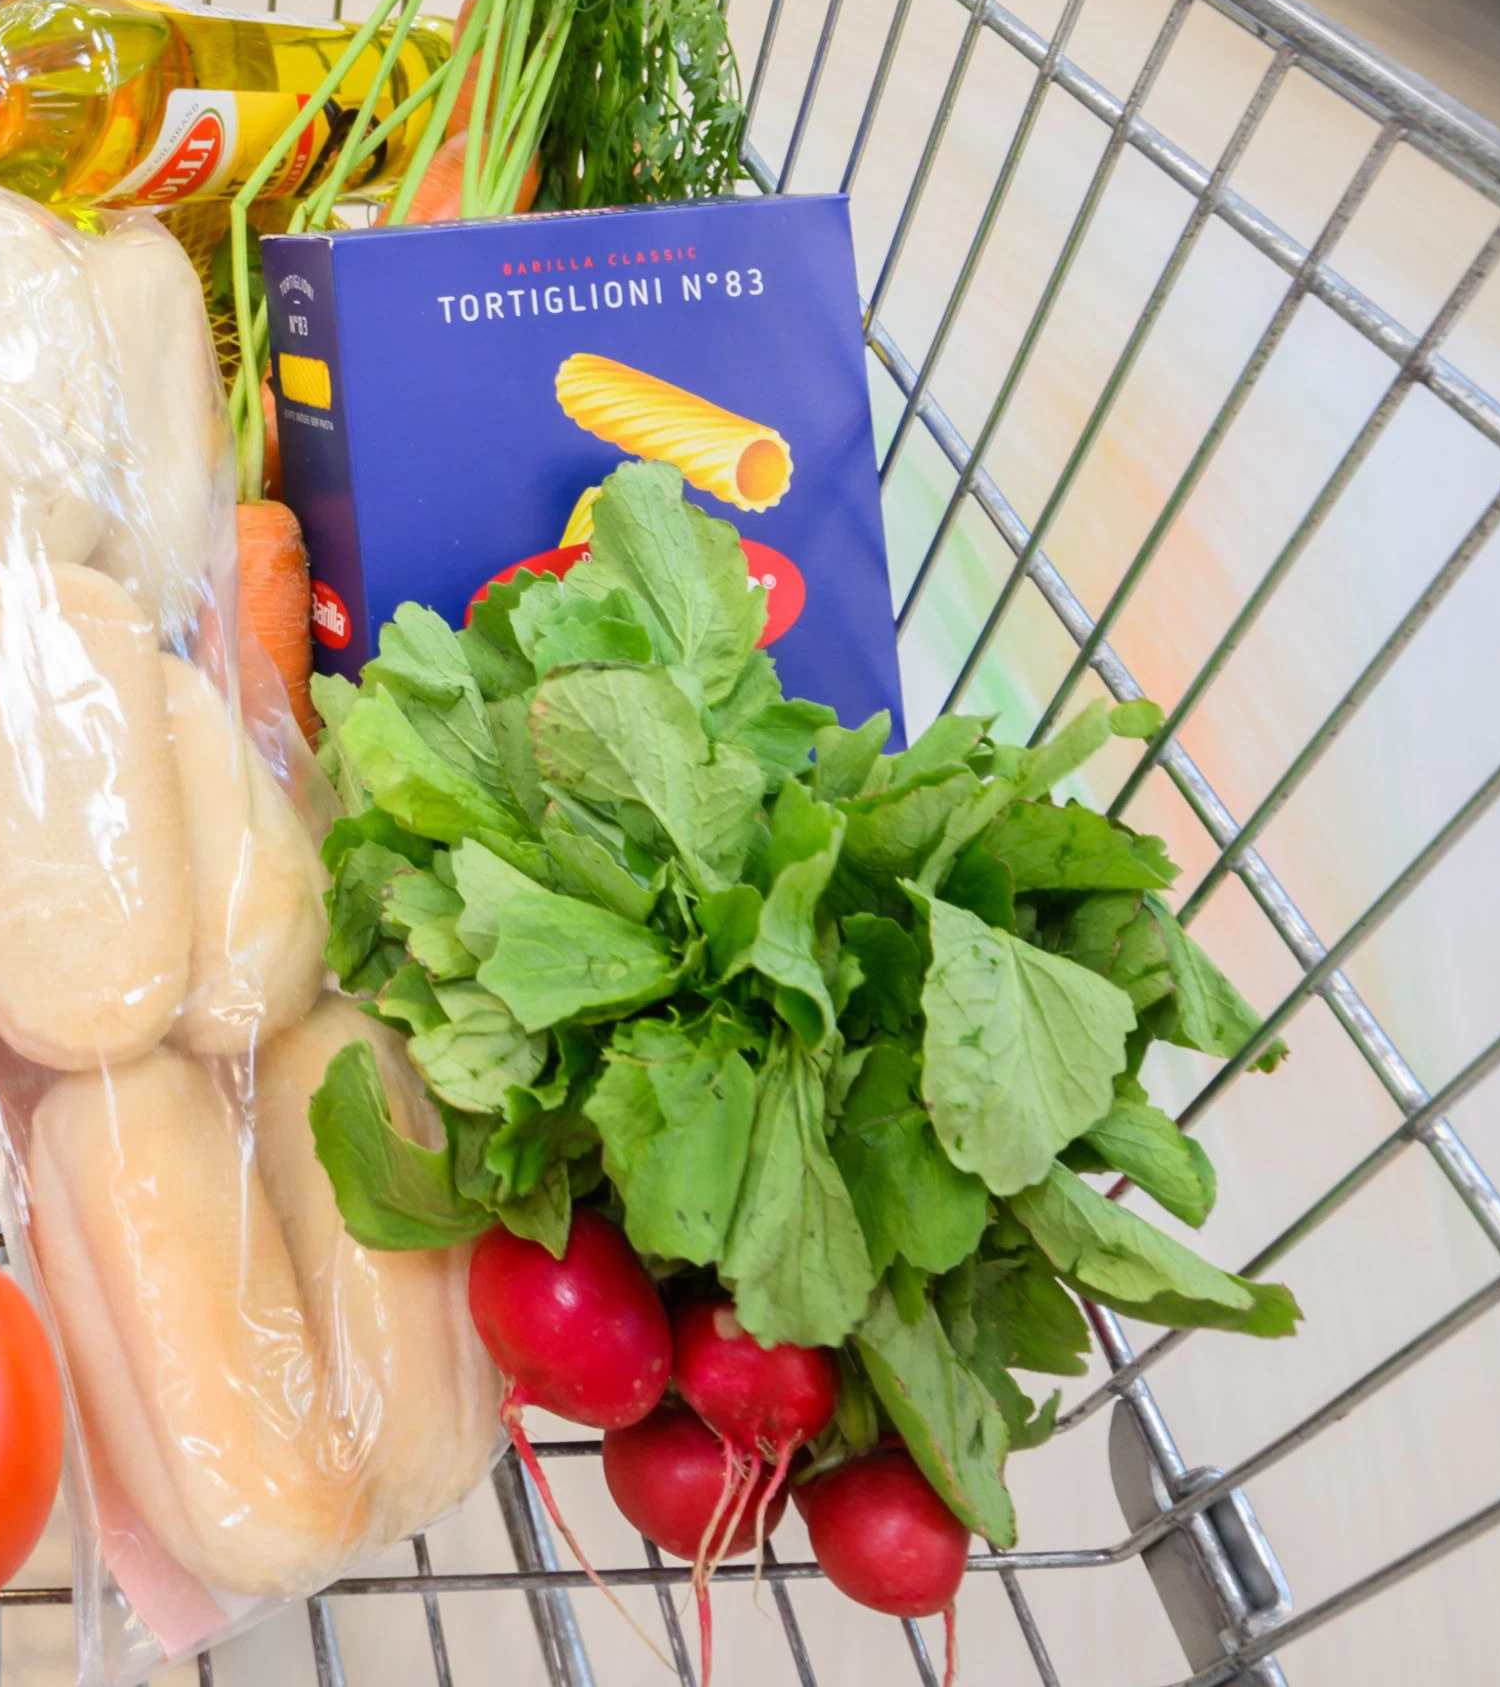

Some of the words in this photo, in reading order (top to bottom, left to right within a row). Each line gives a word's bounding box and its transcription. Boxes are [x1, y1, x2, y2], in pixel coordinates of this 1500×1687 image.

[147, 138, 216, 200] OLLI
[503, 256, 594, 277] BARILLA
[608, 246, 698, 268] CLASSIC
[279, 274, 315, 302] TORTIGLIONI
[437, 277, 663, 324] TORTIGLIONI
[682, 268, 765, 302] N°83
